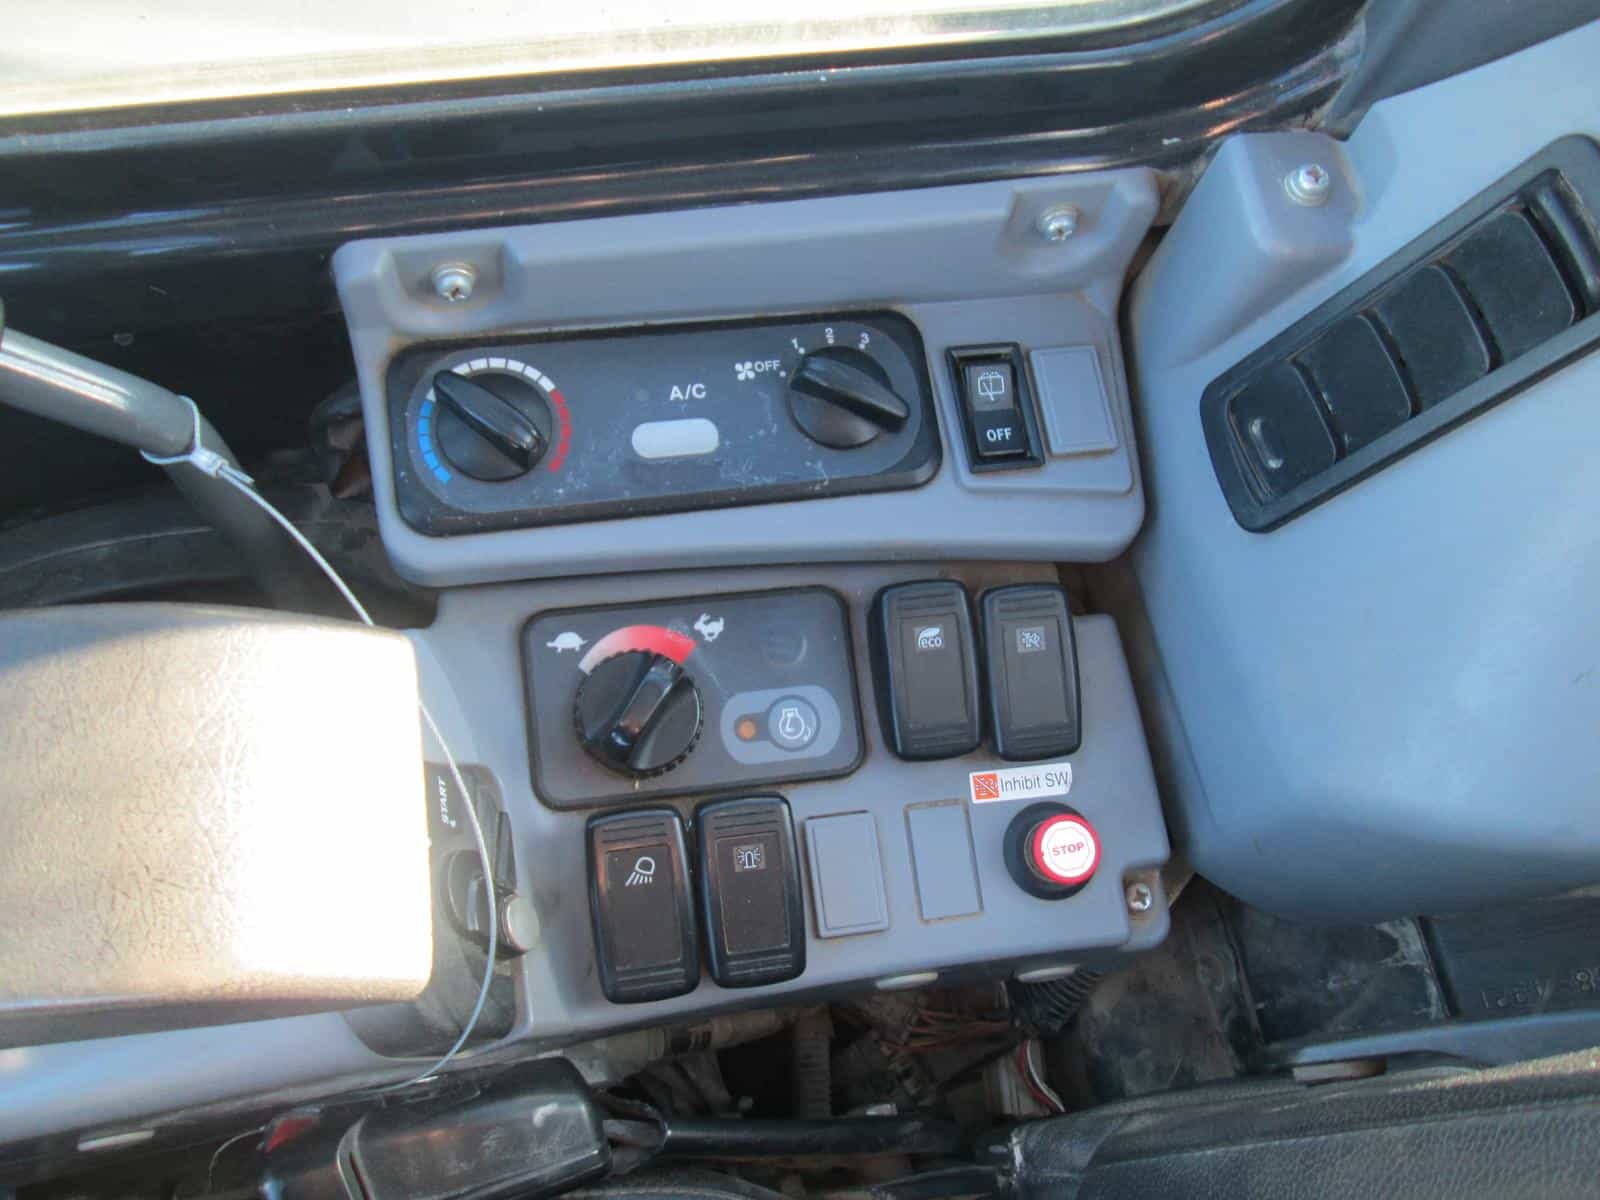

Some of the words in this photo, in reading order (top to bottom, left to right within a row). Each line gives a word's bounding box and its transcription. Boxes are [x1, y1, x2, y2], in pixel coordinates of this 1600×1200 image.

[825, 327, 834, 340] 2
[861, 332, 870, 345] 3
[791, 336, 799, 350] 1
[754, 359, 781, 373] OFF
[669, 383, 707, 401] A/C
[986, 427, 1012, 443] OFF
[1000, 774, 1041, 792] Inhibit
[1044, 770, 1070, 788] SW
[1052, 841, 1085, 857] STOP
